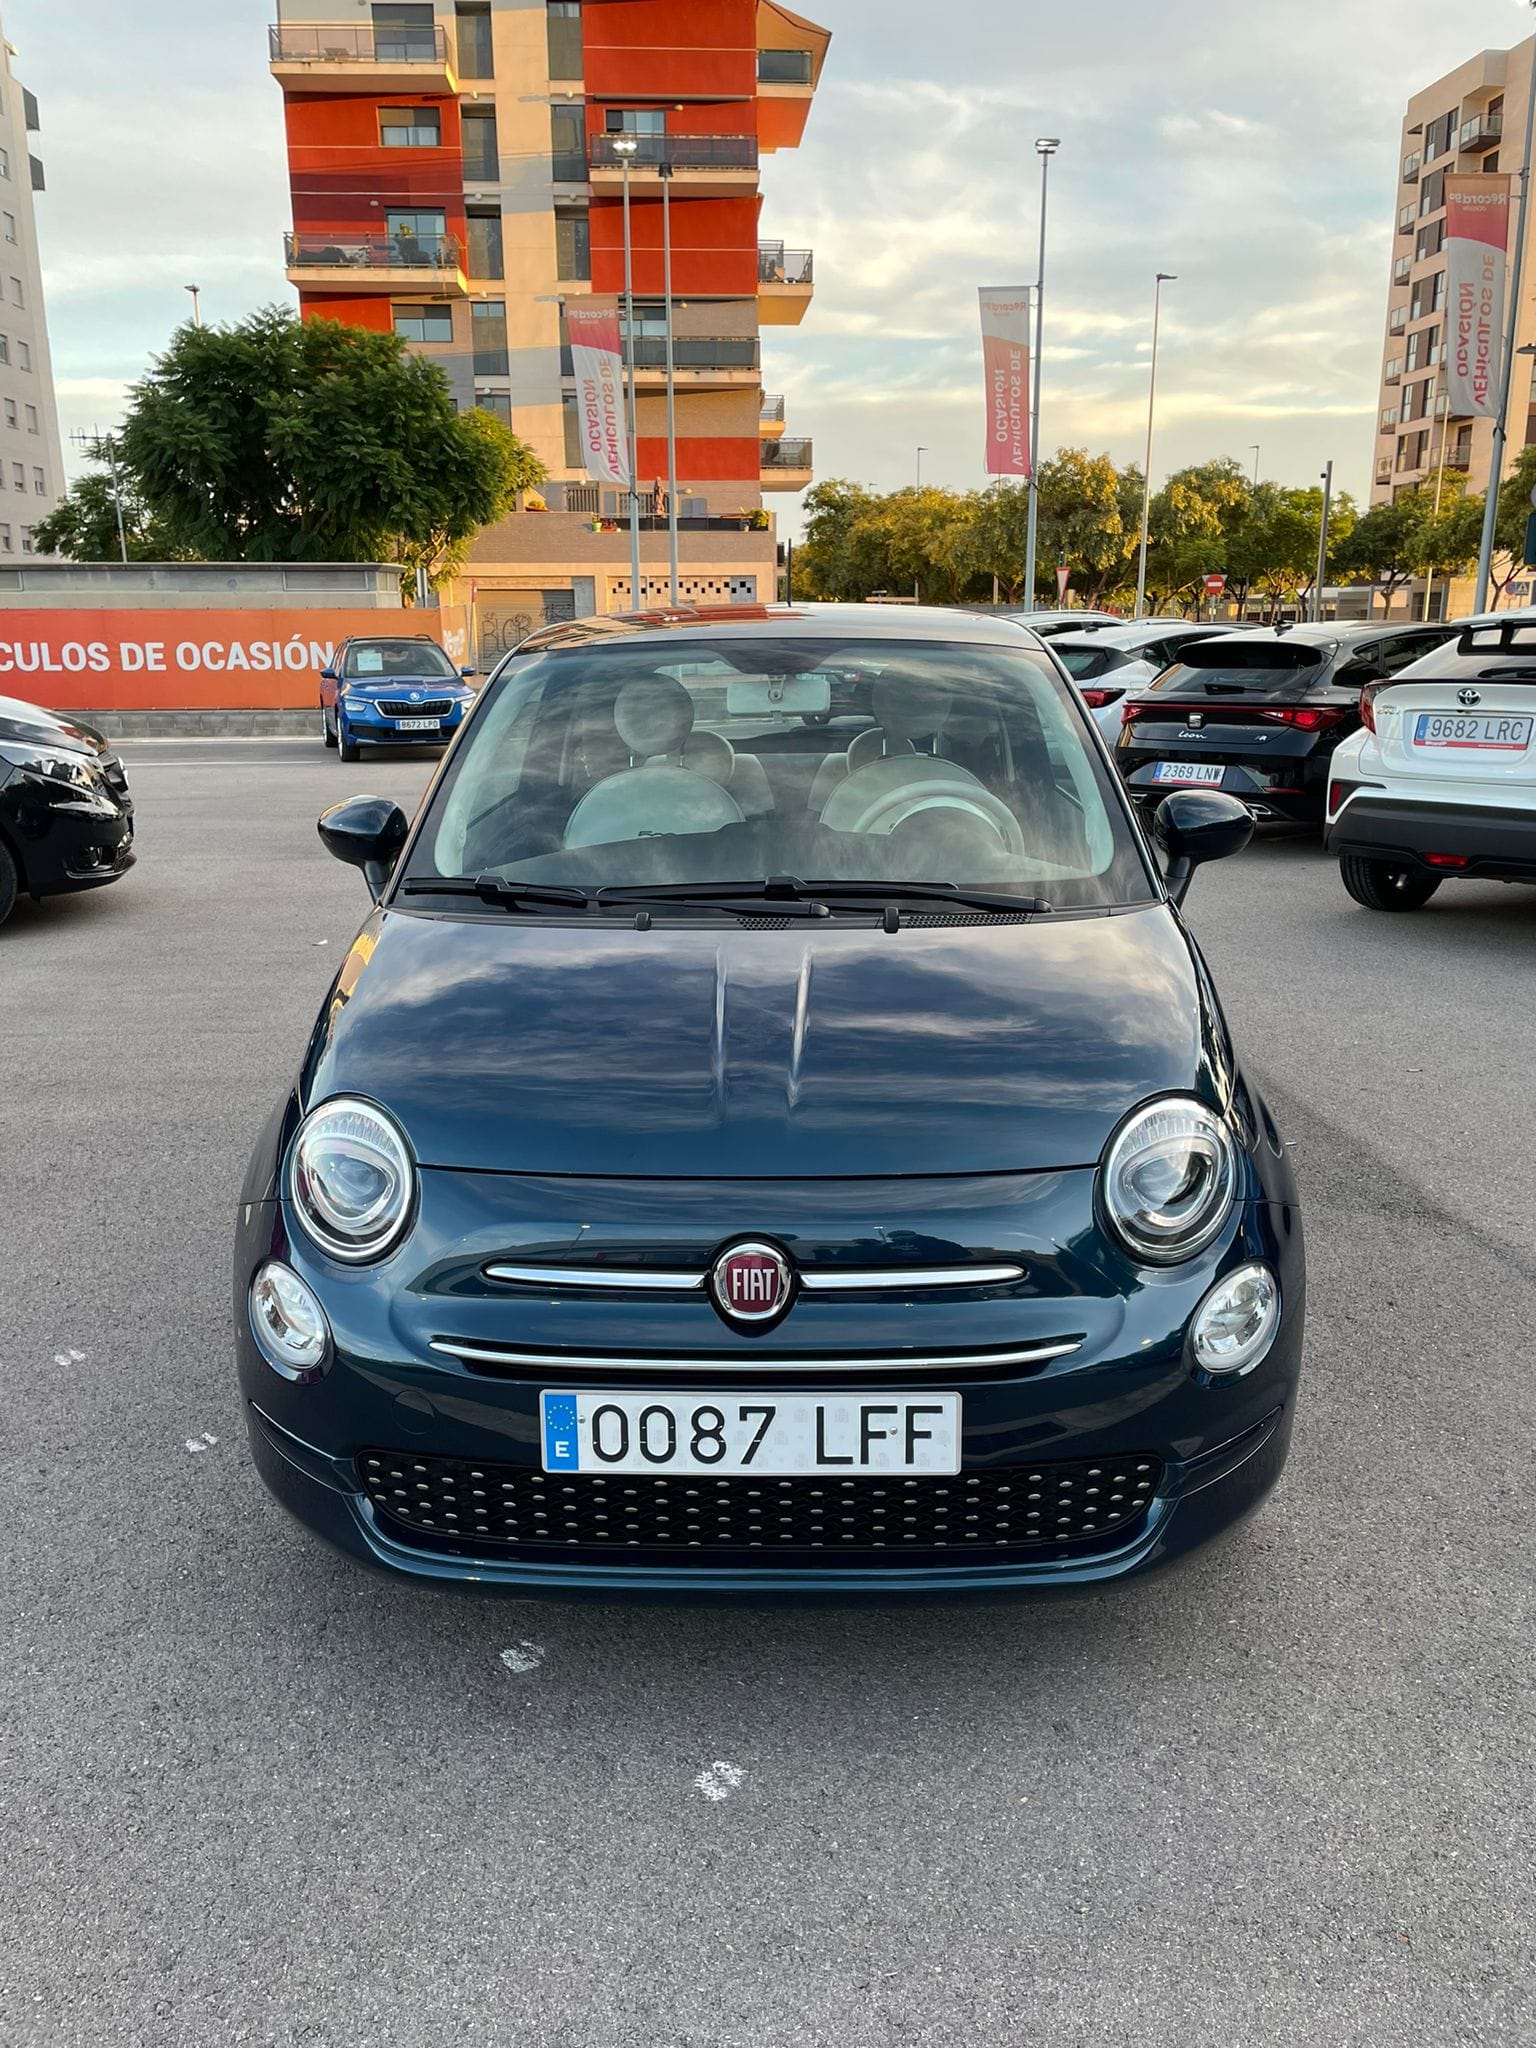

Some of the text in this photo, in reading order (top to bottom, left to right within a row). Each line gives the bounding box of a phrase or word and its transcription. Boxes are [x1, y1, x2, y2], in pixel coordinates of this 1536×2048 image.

[0, 642, 111, 672] CULOS
[119, 642, 167, 672] DE
[175, 633, 334, 672] OCASIÓN
[1431, 719, 1523, 741] 9682 LRC
[1163, 765, 1194, 779] 2369
[1196, 767, 1221, 781] LNW
[732, 1268, 775, 1301] FIAT
[592, 1403, 943, 1465] 0087 LFF
[555, 1441, 570, 1458] E
